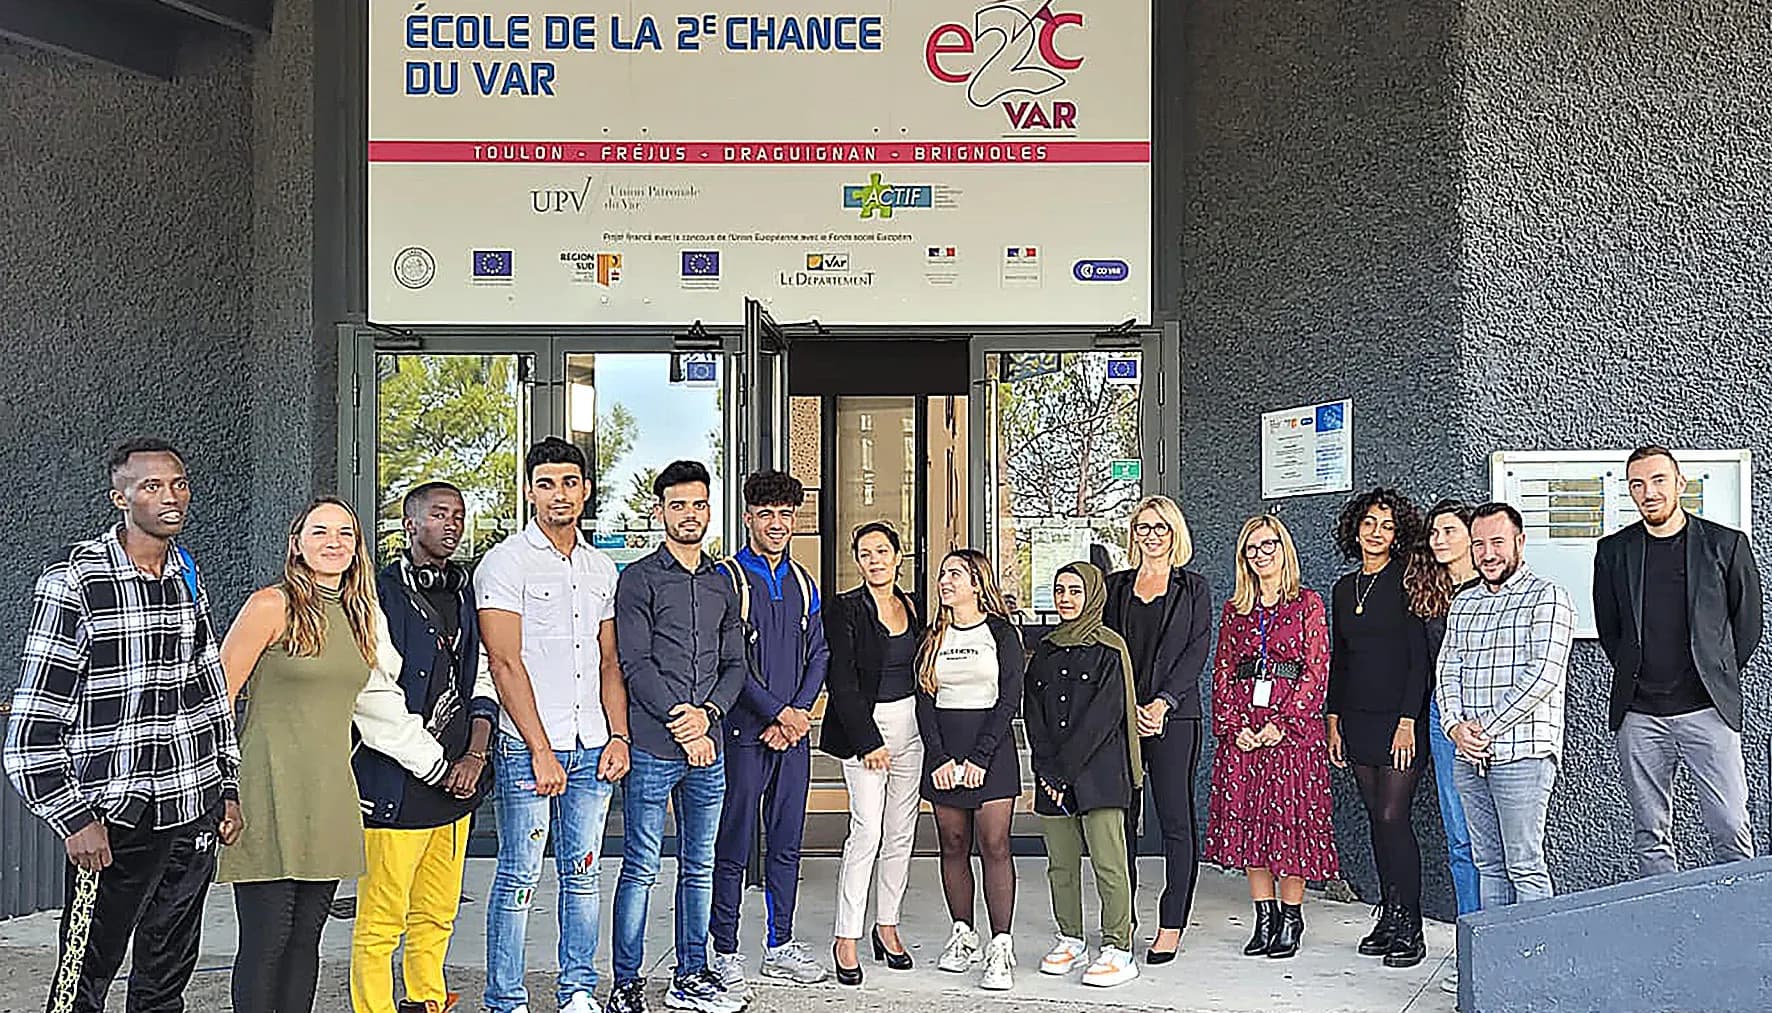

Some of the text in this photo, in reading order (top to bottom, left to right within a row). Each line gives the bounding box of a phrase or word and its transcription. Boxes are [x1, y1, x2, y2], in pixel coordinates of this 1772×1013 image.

[406, 2, 529, 49] ÉCOLE
[545, 15, 595, 50] DE
[611, 15, 662, 50] LA
[726, 16, 882, 50] CHANCE
[406, 61, 555, 96] DU VAR
[1001, 101, 1077, 129] VAR
[473, 146, 563, 160] TOULON
[601, 143, 686, 161] FRÉJUS
[724, 146, 877, 161] DRAGUIGNAN
[914, 146, 1047, 161] BRIGNOLES
[530, 176, 592, 213] UPV
[864, 187, 921, 207] ACTIF
[576, 262, 595, 270] SUD
